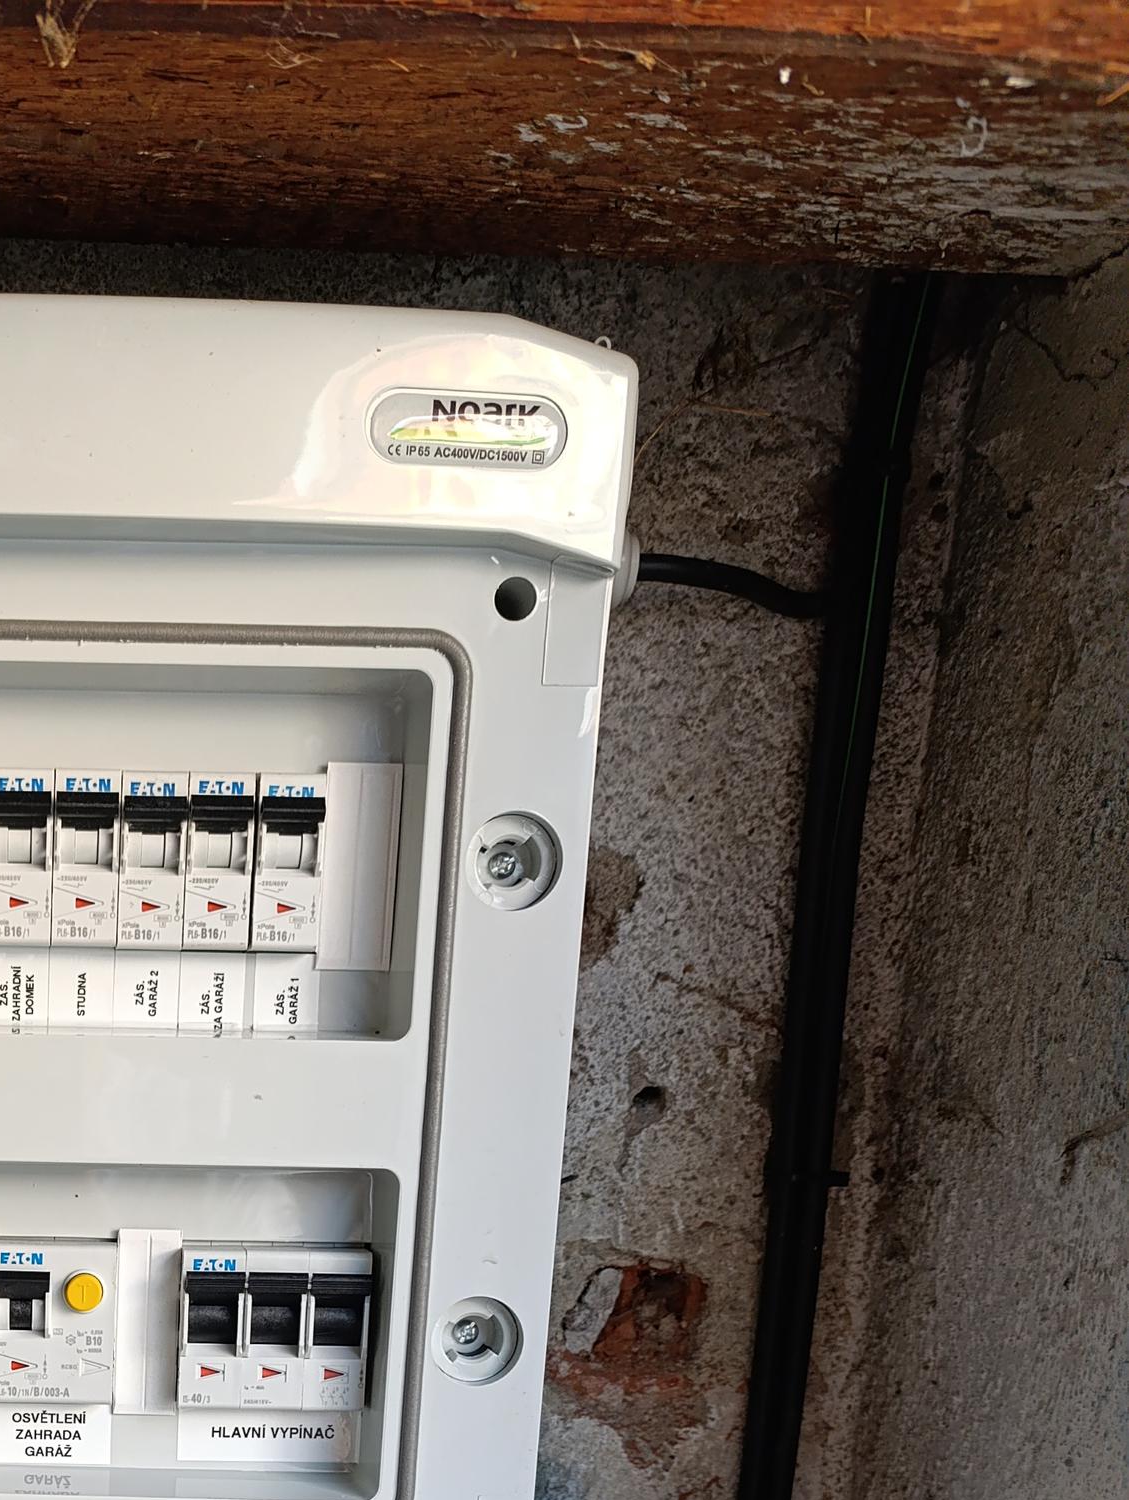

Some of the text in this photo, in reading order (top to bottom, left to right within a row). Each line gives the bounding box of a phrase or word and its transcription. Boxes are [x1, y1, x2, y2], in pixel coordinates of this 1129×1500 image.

[434, 446, 528, 462] AC400V/DC1500V
[66, 778, 111, 791] EATON
[130, 782, 176, 797] EATON
[198, 781, 244, 794] EATON
[268, 785, 315, 797] EATON
[11, 966, 21, 1021] ZAHRADNÍ
[25, 974, 34, 1015] DOMEK
[77, 972, 86, 1016] STUDNA
[135, 980, 145, 1006] ZÁS.
[147, 980, 158, 1017] GARÁŽ
[214, 972, 224, 1014] GARÁŽÍ
[200, 989, 210, 1015] ZÁS.
[275, 989, 285, 1015] ZÁS.
[287, 985, 298, 1024] GARÁŽ
[0, 1252, 43, 1265] EATON
[193, 1259, 236, 1271] EATON
[86, 1336, 102, 1346] B10
[12, 1411, 86, 1424] OSVĚTLENÍ
[15, 1430, 82, 1441] ZAHRADA
[211, 1424, 335, 1439] HLAVNÍ VYPÍNAČ
[25, 1445, 72, 1457] GARÁŽ
